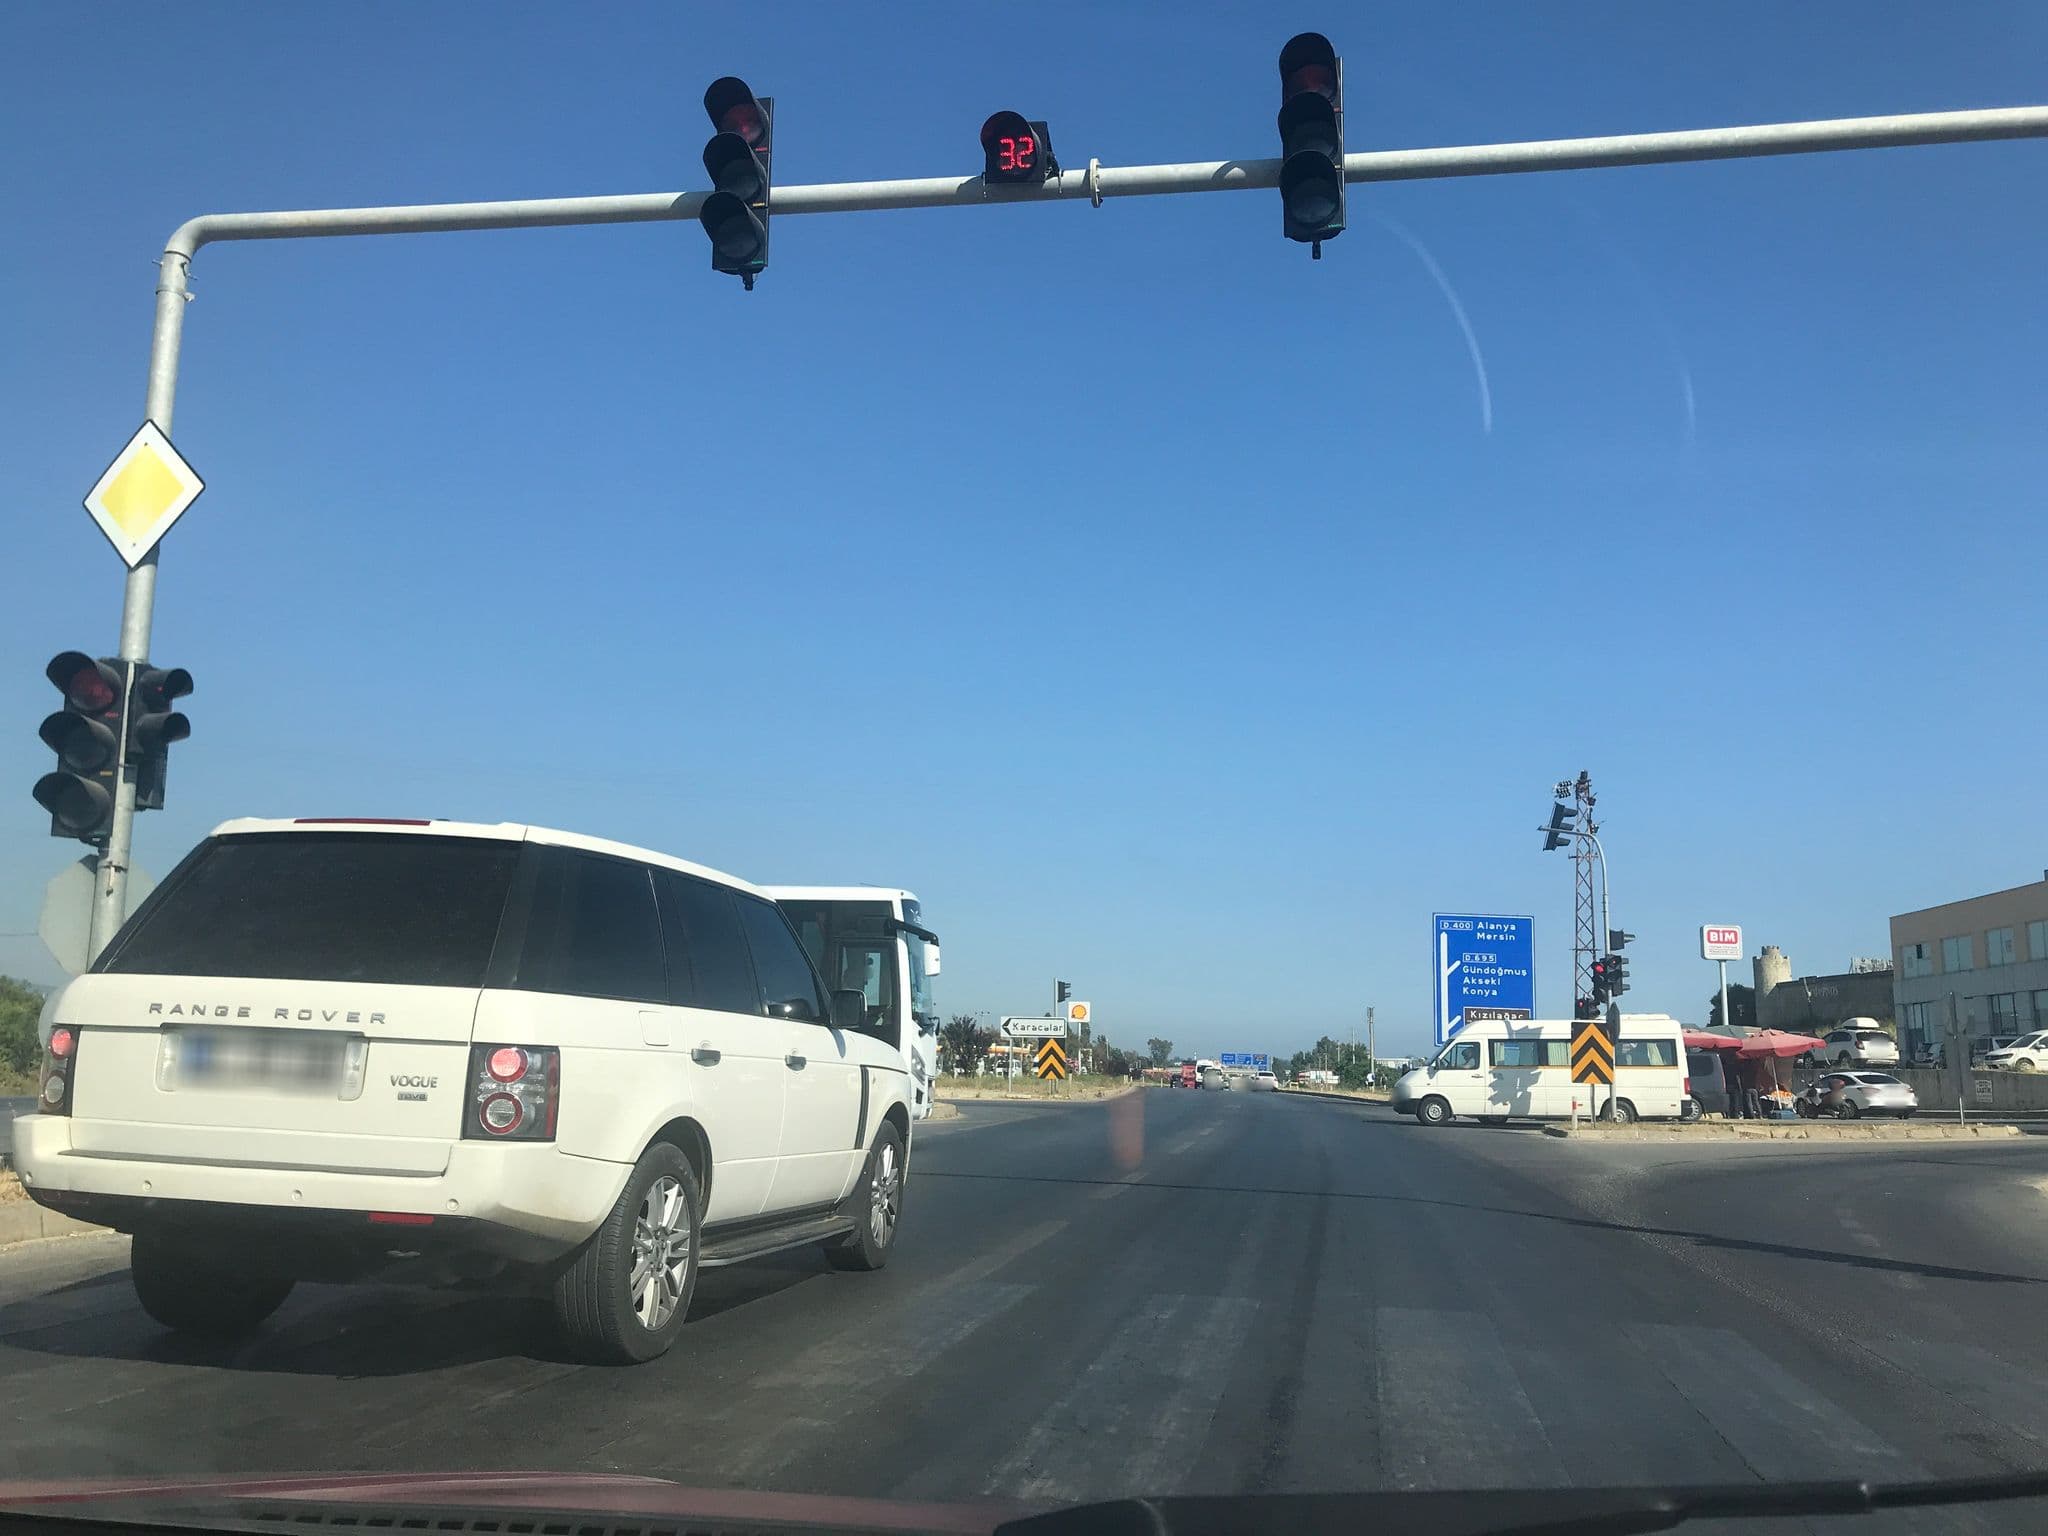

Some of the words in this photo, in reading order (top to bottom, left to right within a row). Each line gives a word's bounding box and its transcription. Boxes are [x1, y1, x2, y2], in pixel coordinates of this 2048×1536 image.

[999, 136, 1035, 170] 32
[1477, 921, 1516, 931] Alanya
[1477, 932, 1515, 941] Mersin
[1462, 965, 1527, 976] Gündoğmuş
[1463, 976, 1501, 985] Akseki
[1462, 987, 1498, 996] Konya
[148, 1003, 252, 1018] RANGE
[274, 1007, 386, 1024] ROVER
[1012, 1022, 1063, 1032] Karacalar
[390, 1075, 438, 1089] VOGUE
